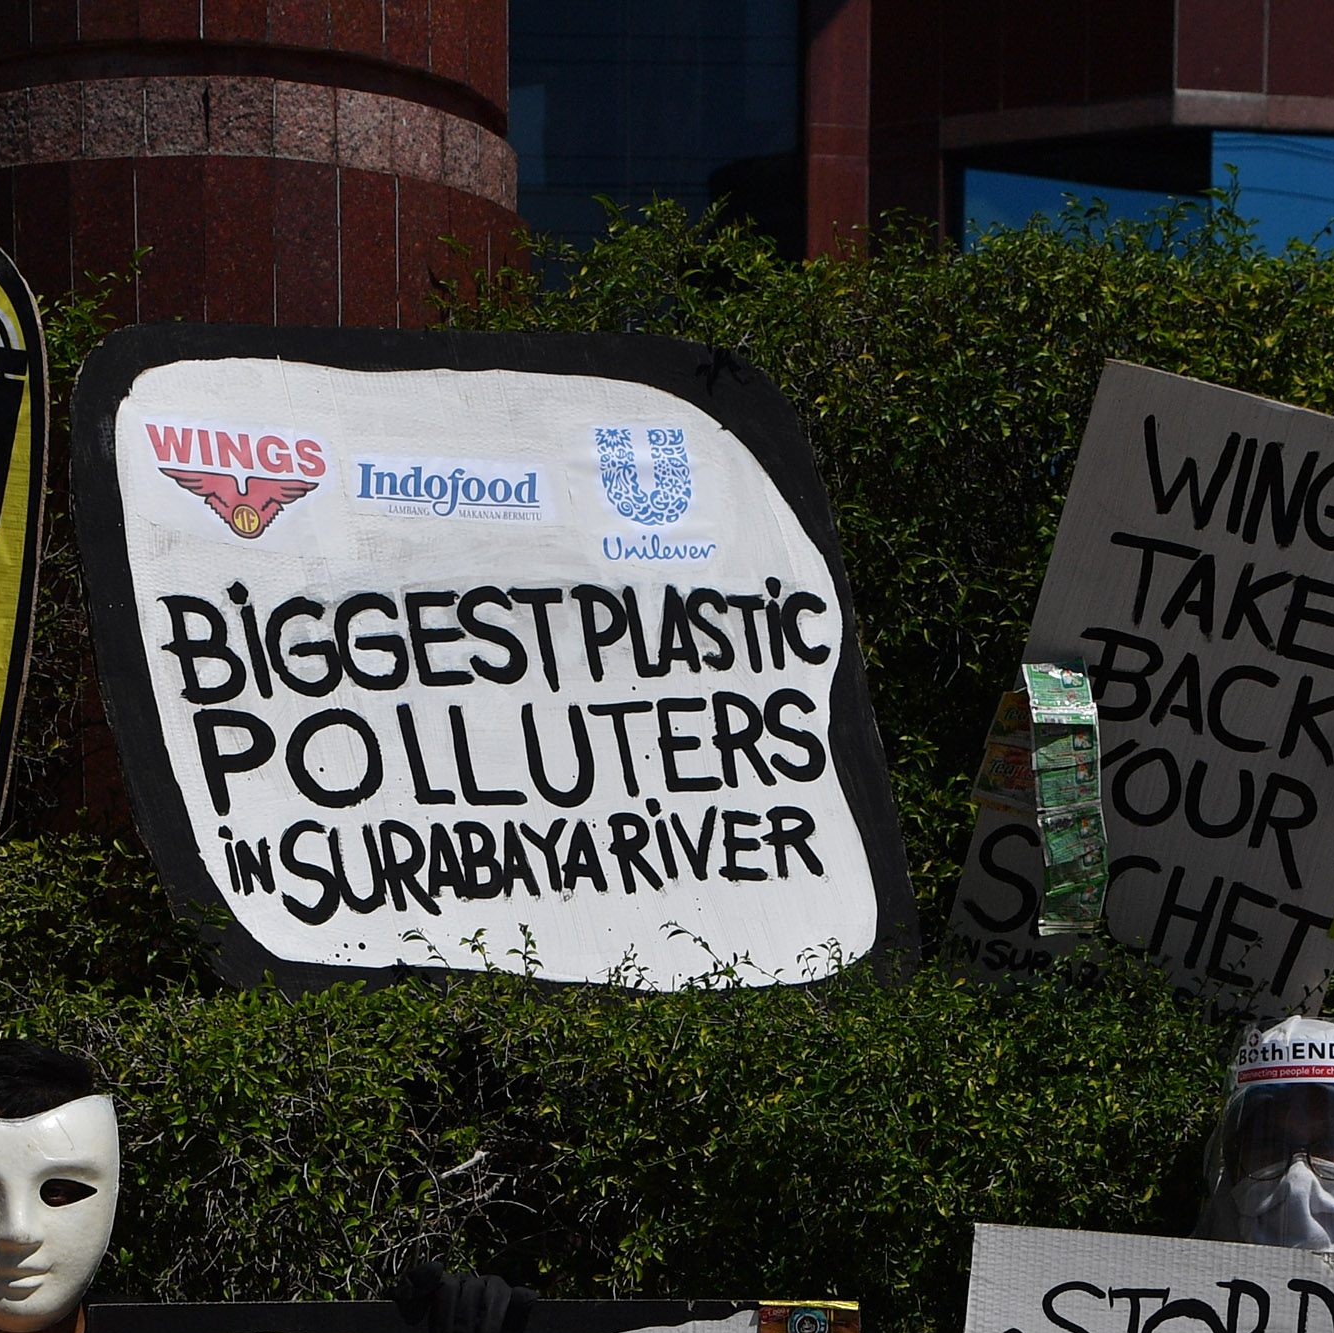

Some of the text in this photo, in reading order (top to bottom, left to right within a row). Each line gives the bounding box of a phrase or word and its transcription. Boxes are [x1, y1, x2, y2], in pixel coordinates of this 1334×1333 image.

[145, 423, 326, 477] WINGS
[357, 463, 539, 516] Indofood
[388, 504, 542, 521] LAMBANG MAKANAN BERMUTU
[602, 534, 717, 562] Unilever
[193, 688, 828, 816] POLLUTERS
[279, 817, 607, 925] SURABAYA
[962, 822, 1334, 996] SCHET
[1239, 1043, 1283, 1066] Both
[1239, 1068, 1278, 1081] Connecting
[1279, 1067, 1310, 1078] people
[1311, 1066, 1324, 1075] for
